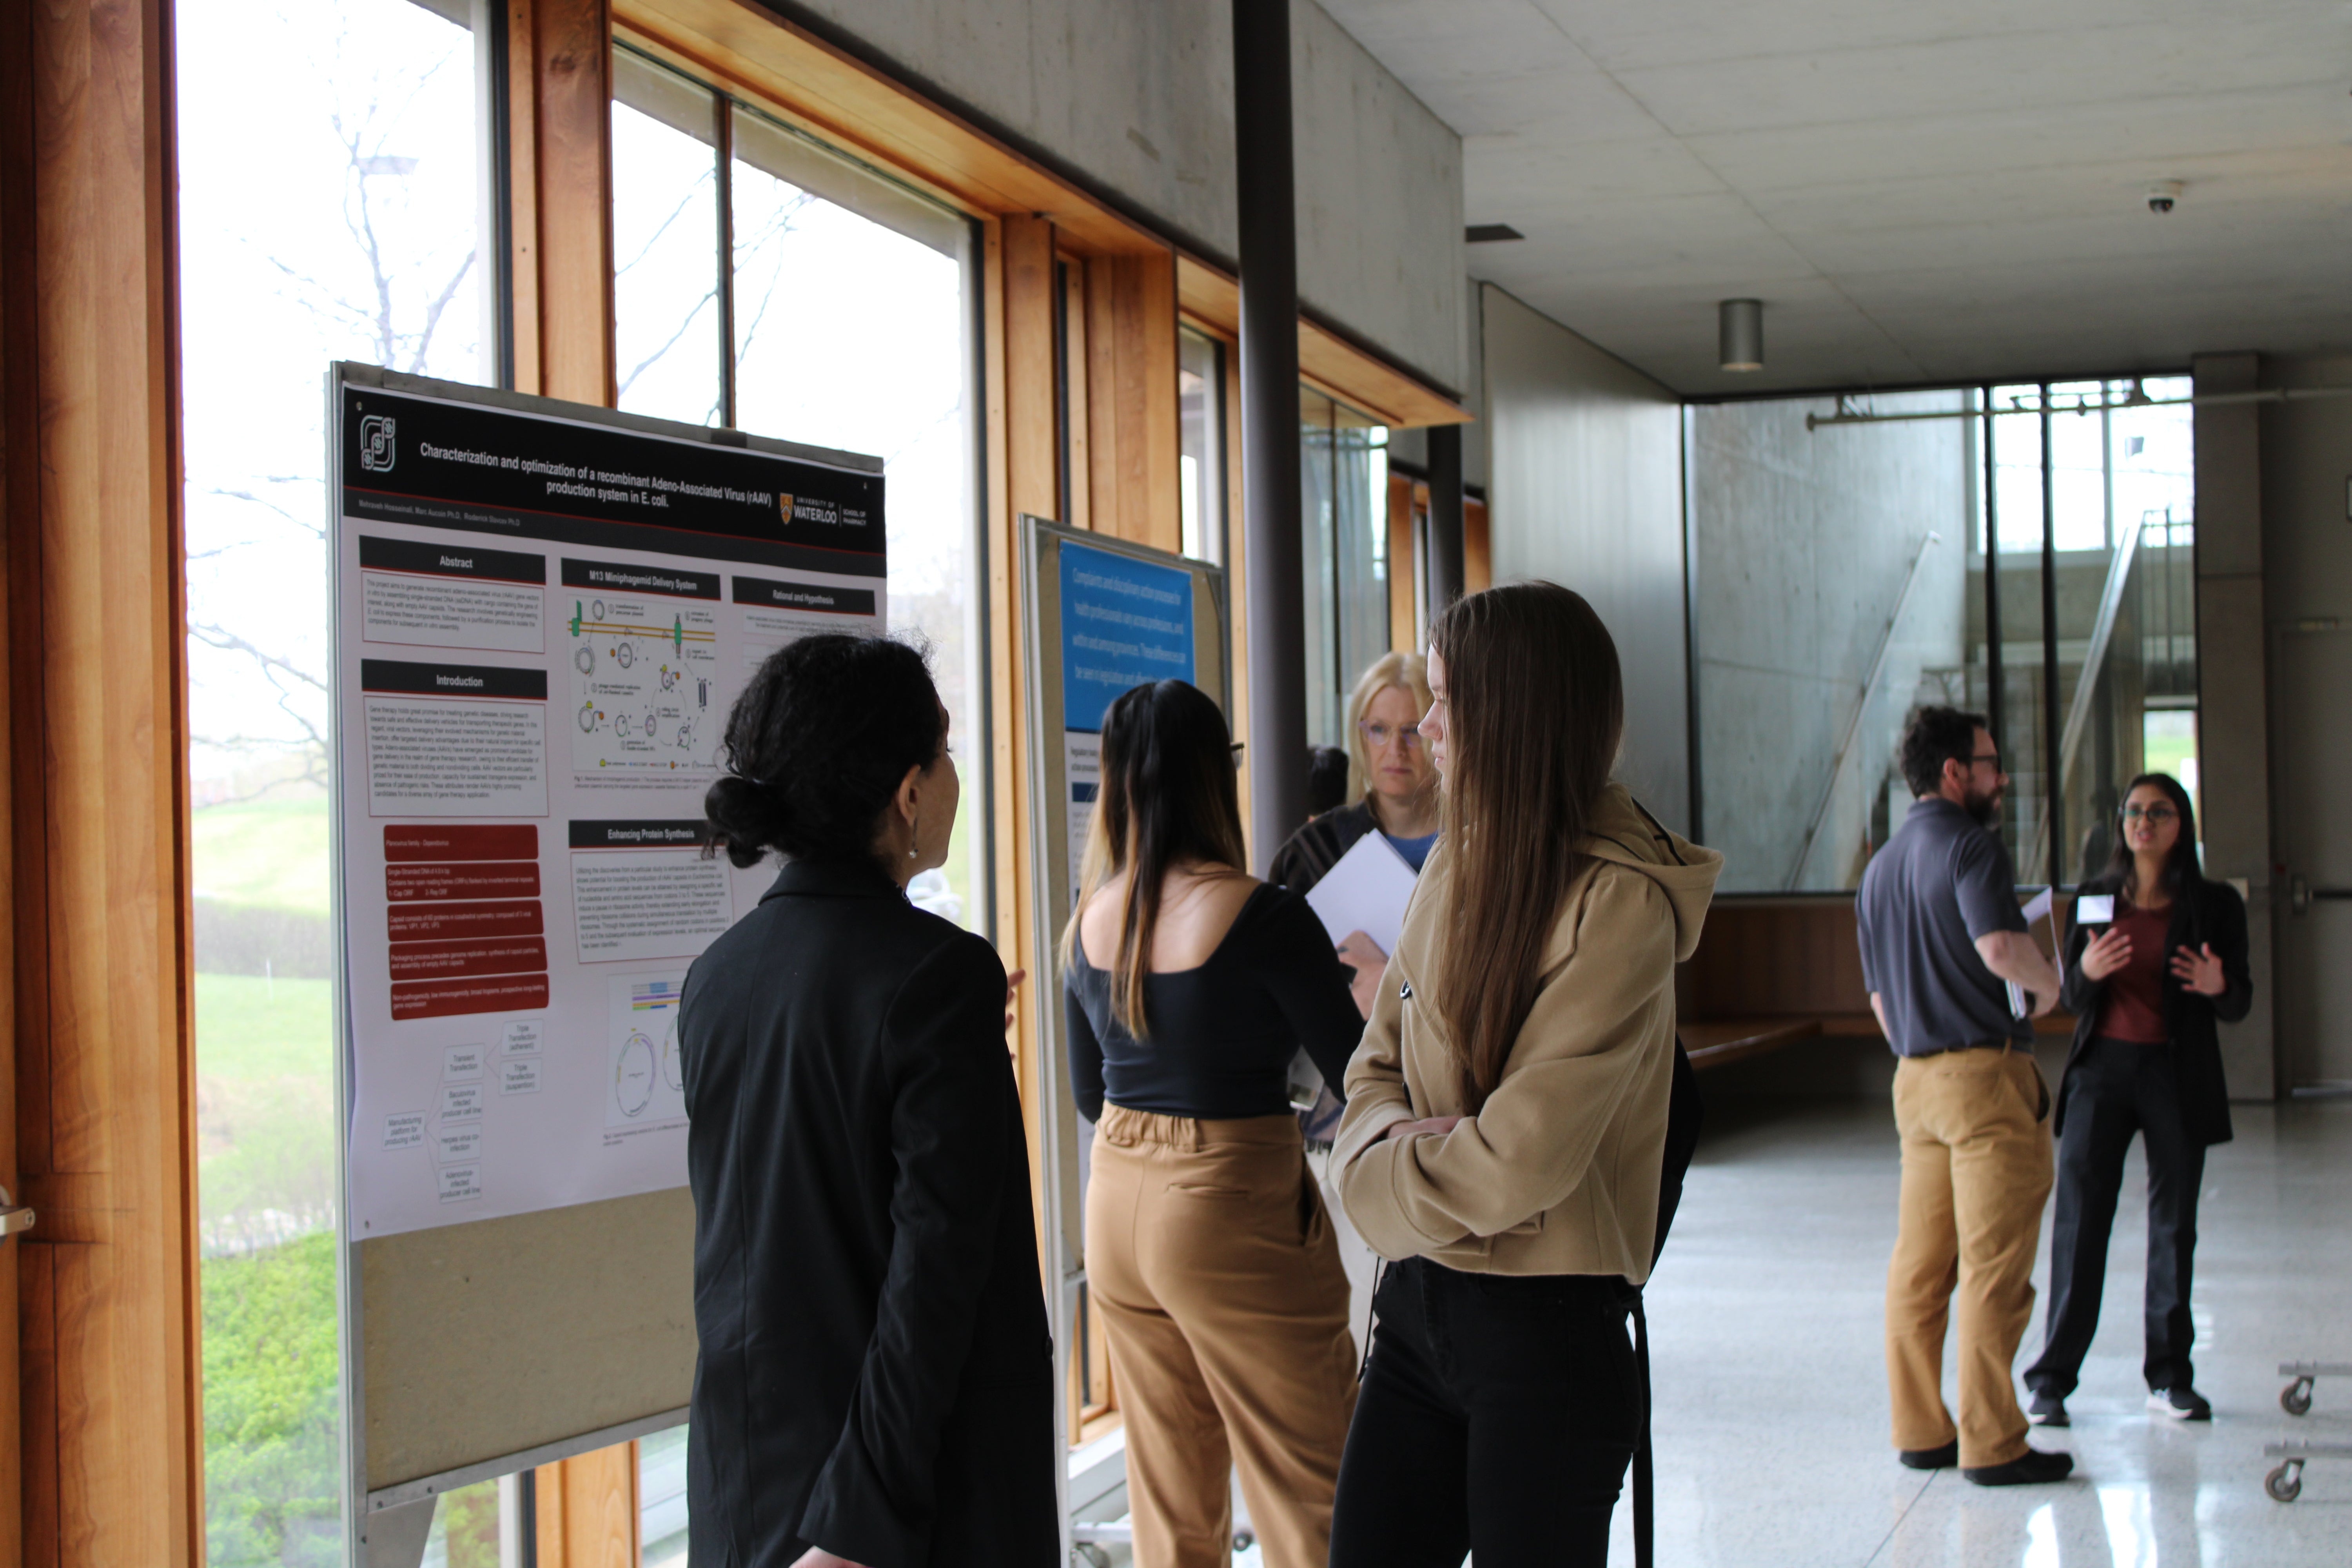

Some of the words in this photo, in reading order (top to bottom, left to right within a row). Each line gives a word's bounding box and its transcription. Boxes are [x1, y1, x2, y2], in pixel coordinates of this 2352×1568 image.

[421, 442, 498, 468] Characterization
[501, 456, 519, 469] and
[521, 458, 575, 478] optimization
[577, 466, 588, 479] of
[590, 471, 595, 480] a
[597, 470, 650, 487] recombinant
[652, 476, 723, 499] Adeno-Associated
[724, 488, 745, 501] Virus
[747, 490, 771, 508] (rAAV)
[547, 481, 596, 498] production
[598, 488, 628, 502] system
[631, 490, 639, 502] in
[641, 491, 650, 505] E.
[652, 492, 669, 507] coli.
[797, 496, 826, 506] UNIVERSITY
[794, 504, 837, 523] WATERLOO
[439, 555, 473, 568] Abstract
[589, 570, 604, 581] M13
[605, 572, 651, 586] Miniphagemid
[652, 576, 675, 590] Delivery
[675, 579, 697, 591] System
[772, 589, 793, 600] Rational
[794, 592, 803, 601] and
[805, 593, 834, 605] Hypothesis
[436, 675, 483, 687] Introduction
[608, 829, 640, 841] Enhancing
[641, 829, 663, 838] Protein
[665, 828, 695, 840] Synthesis
